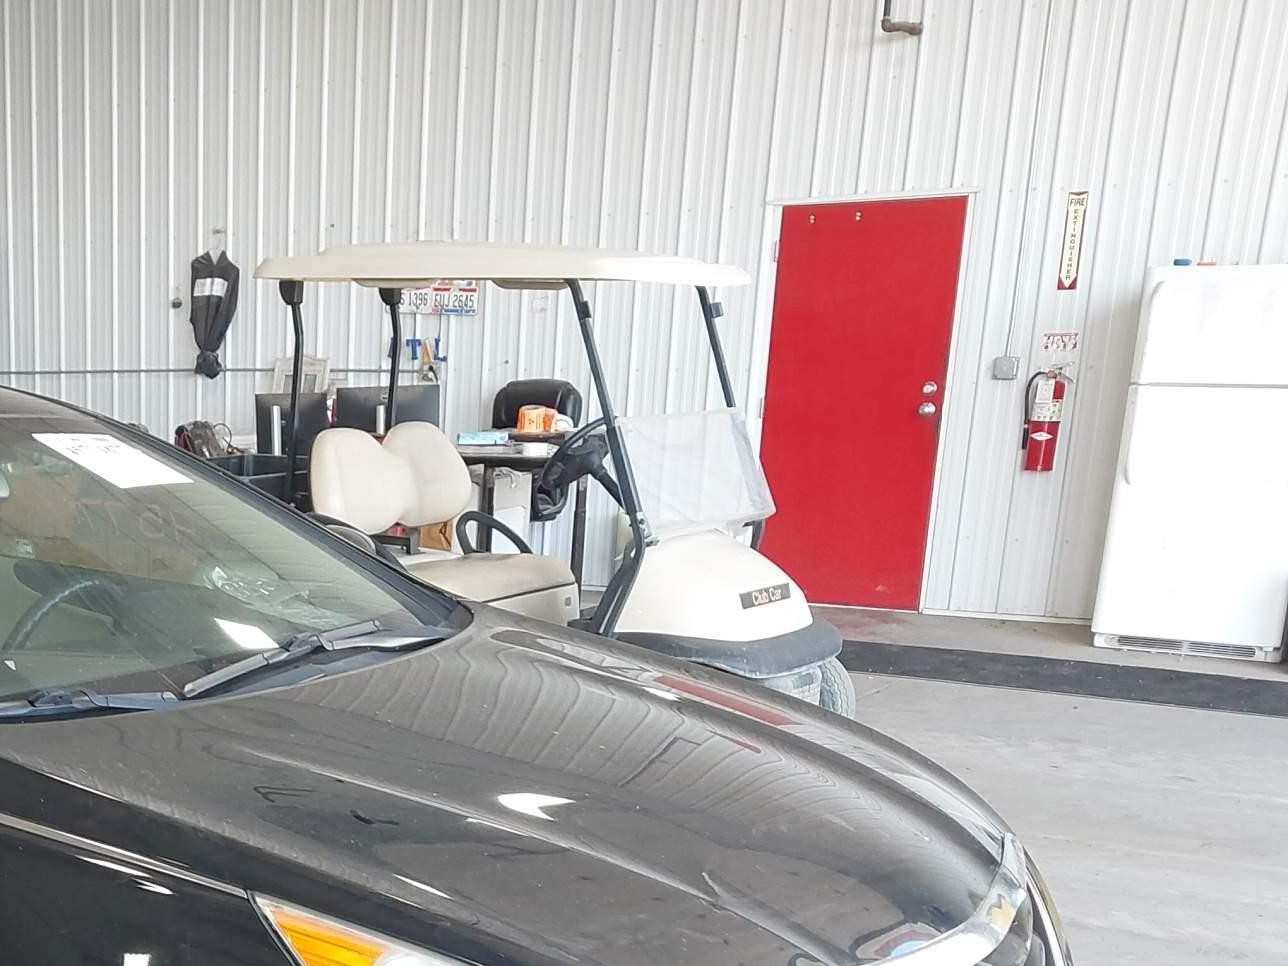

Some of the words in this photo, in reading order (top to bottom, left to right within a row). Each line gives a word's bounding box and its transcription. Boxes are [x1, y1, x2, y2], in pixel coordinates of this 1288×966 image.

[1070, 197, 1086, 207] FIRE
[1065, 208, 1080, 280] EXTINGUISHER
[752, 590, 768, 605] Club
[769, 587, 782, 601] Car
